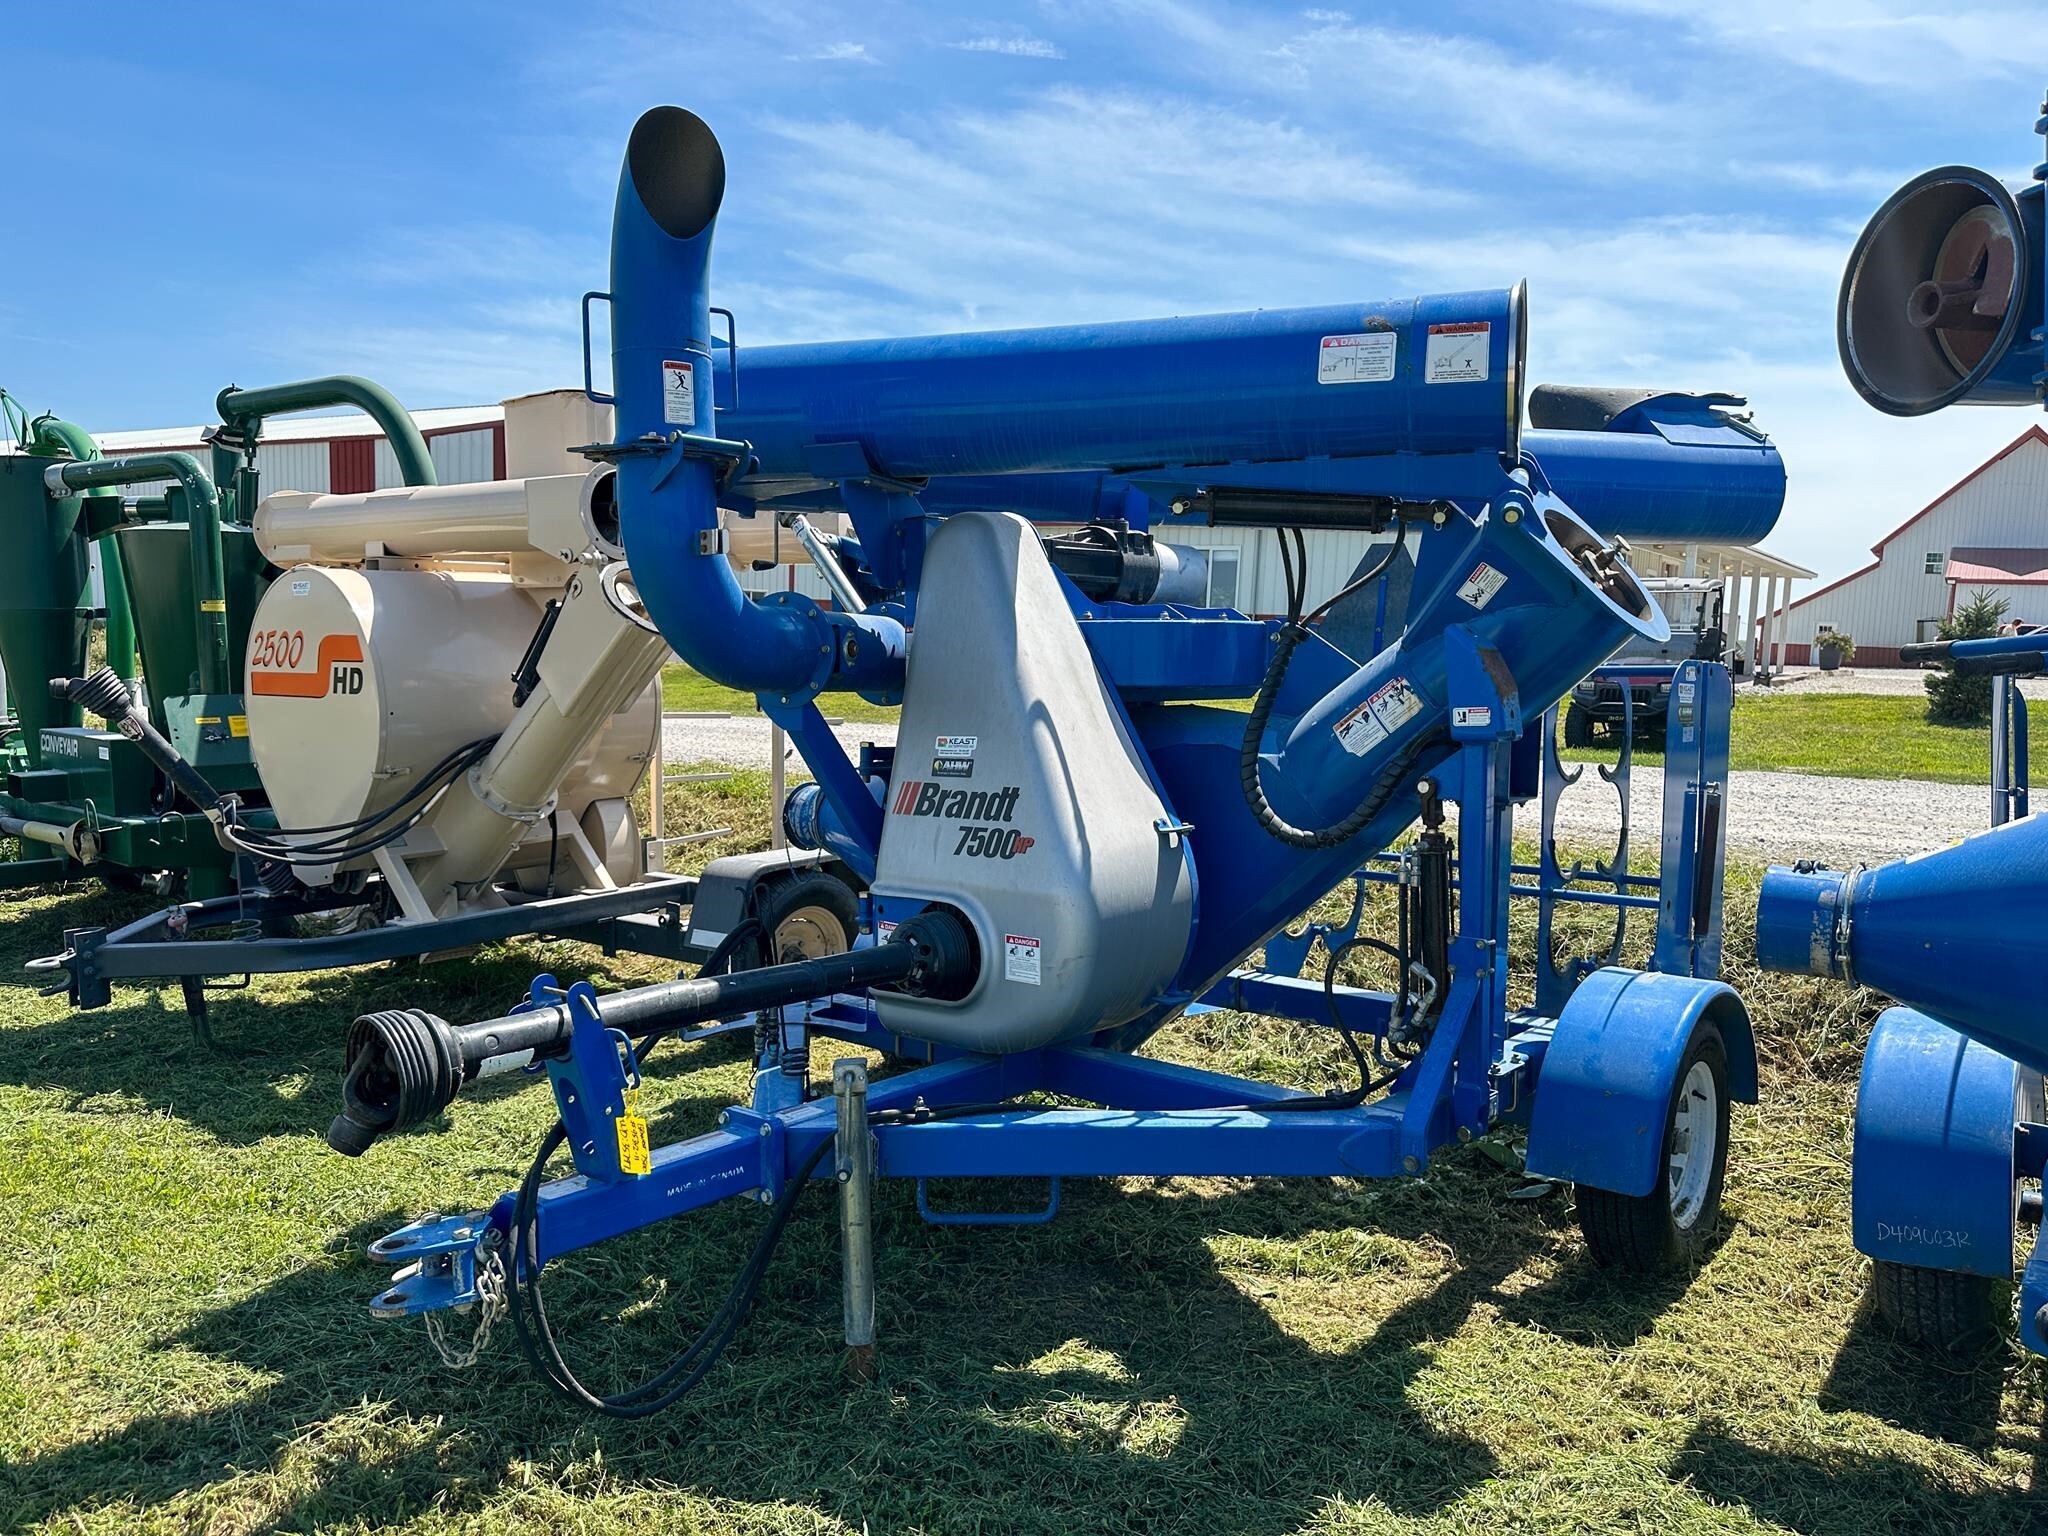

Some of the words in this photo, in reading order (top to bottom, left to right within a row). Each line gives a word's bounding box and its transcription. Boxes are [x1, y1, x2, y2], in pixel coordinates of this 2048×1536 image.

[252, 630, 305, 669] 2500
[333, 667, 364, 695] HD
[40, 734, 79, 758] CONVEYAIR
[912, 782, 1021, 822] Brandt
[1014, 937, 1037, 947] DANGER
